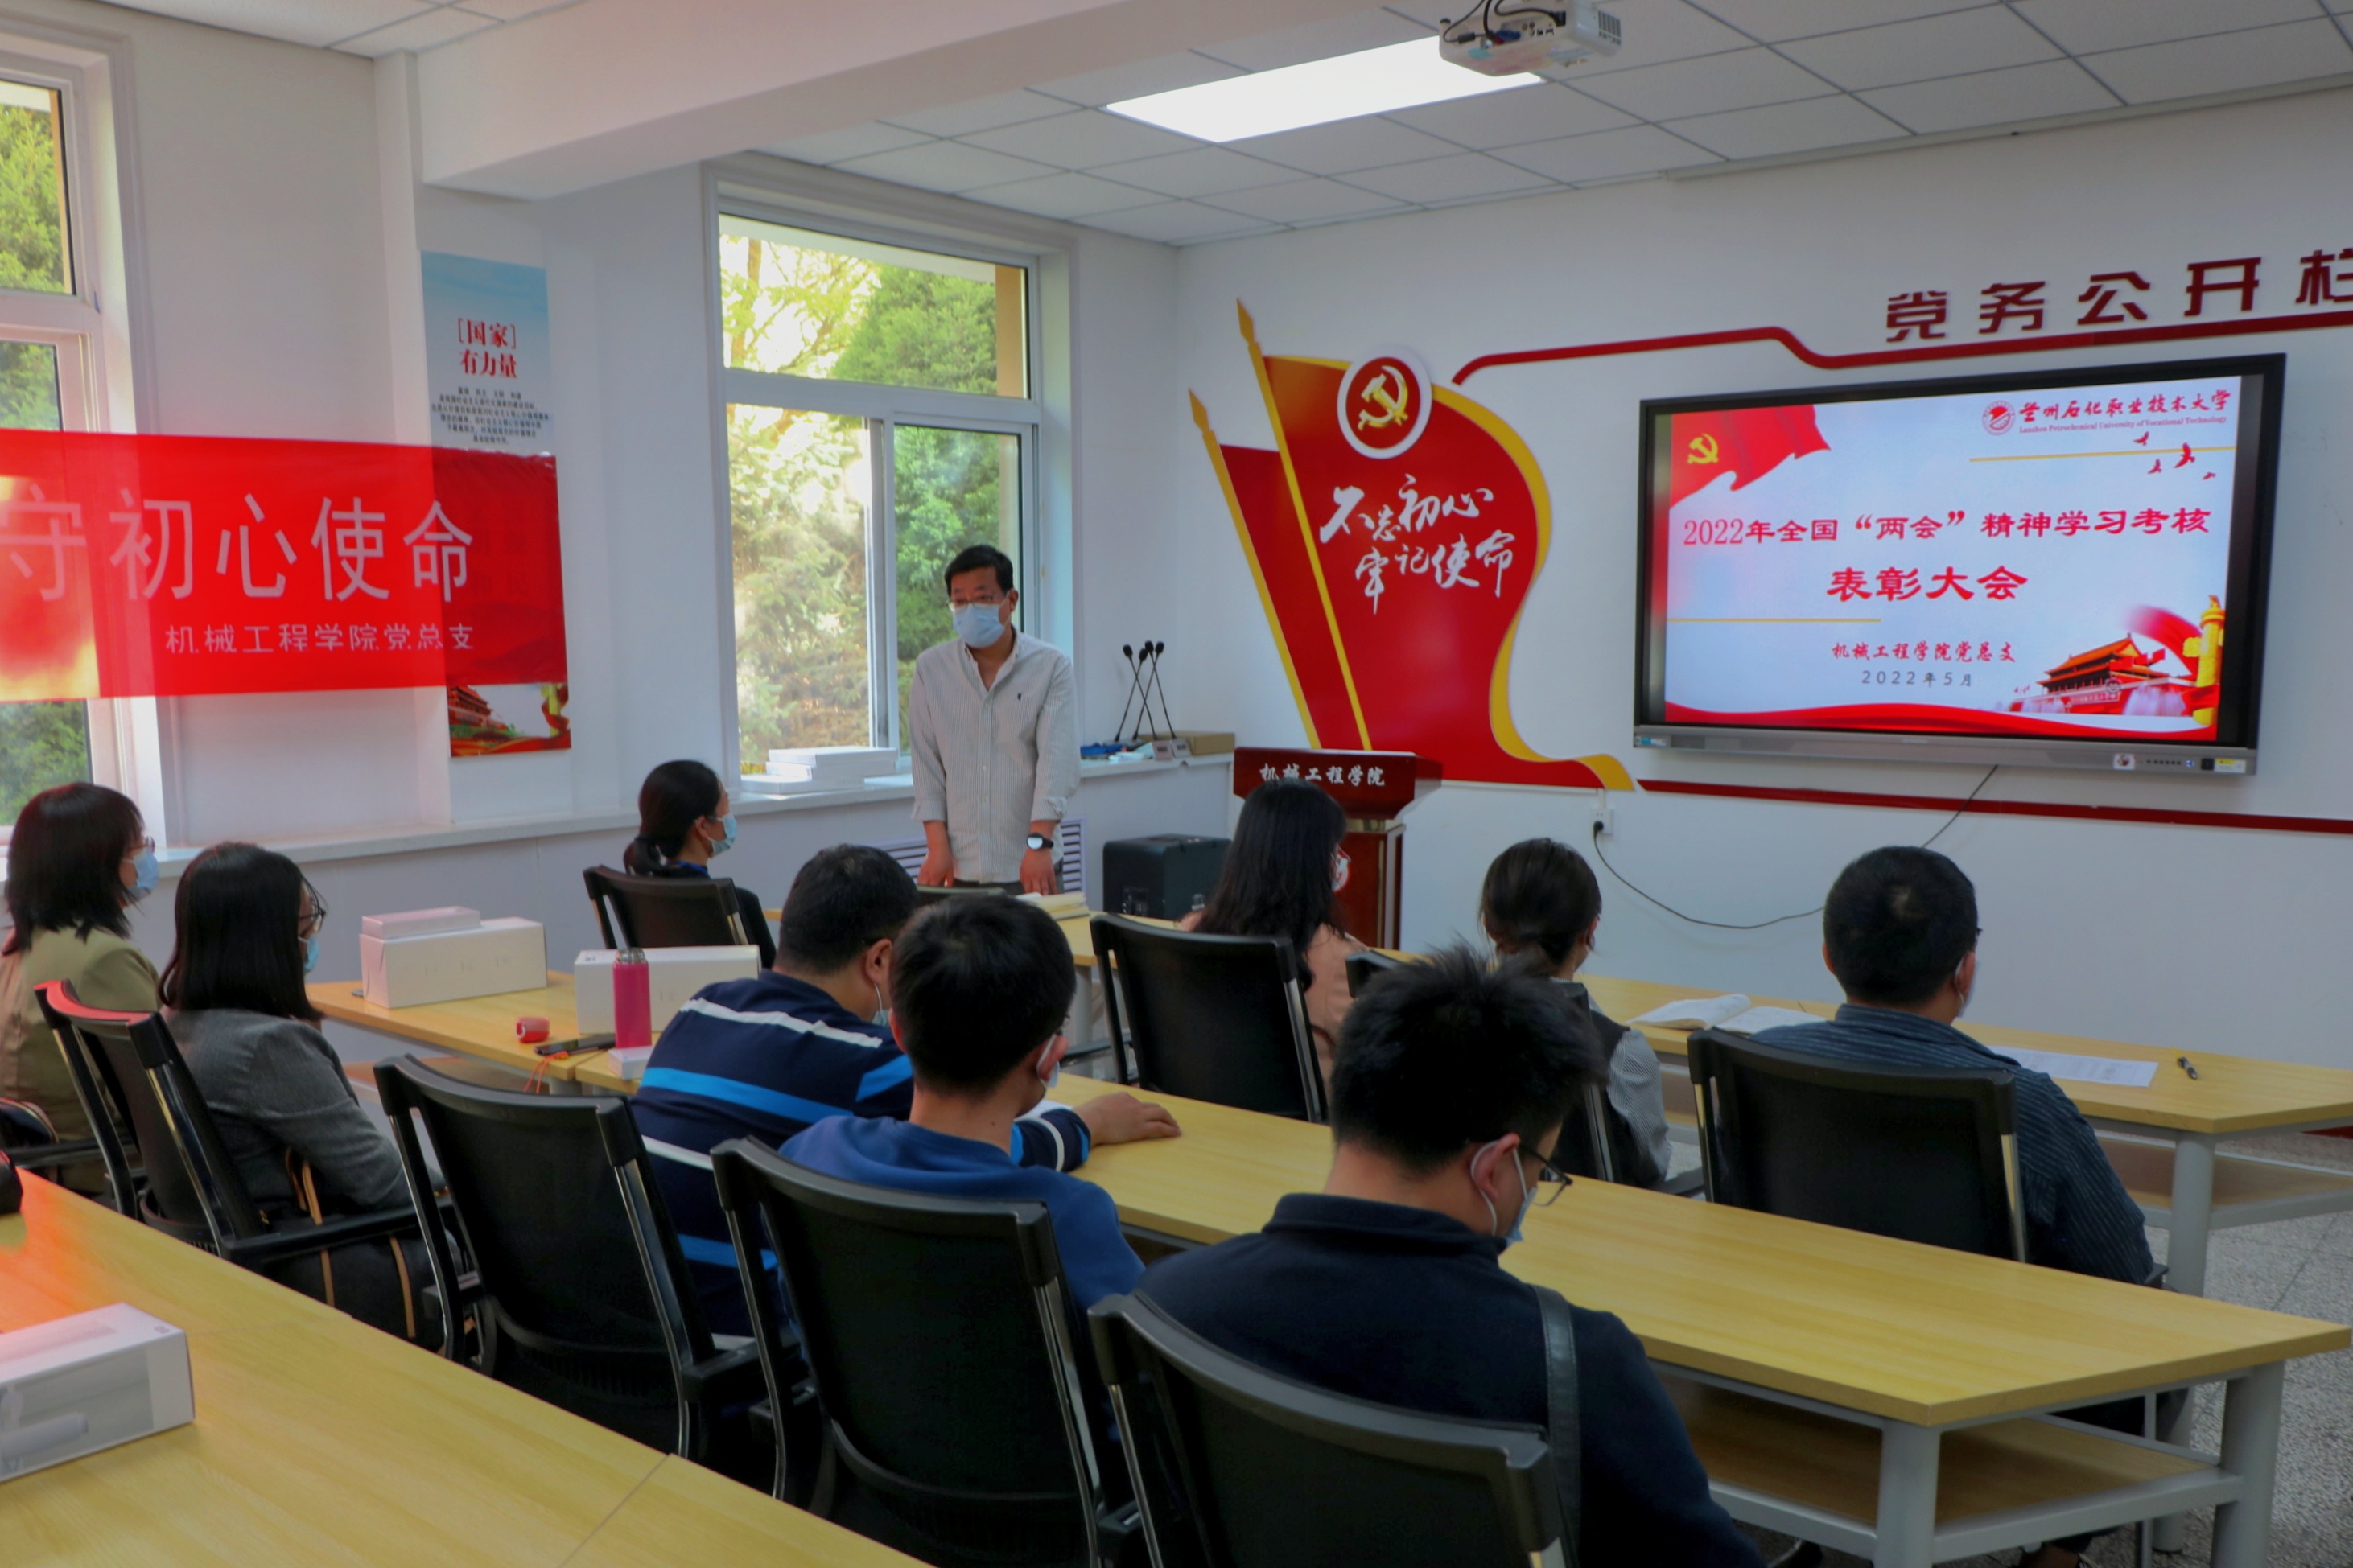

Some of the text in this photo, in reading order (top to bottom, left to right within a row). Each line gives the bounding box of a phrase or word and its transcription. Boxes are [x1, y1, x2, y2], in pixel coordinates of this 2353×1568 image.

[459, 350, 517, 378] 有力量
[2019, 389, 2231, 422] 兰州石化职业技术大学
[2049, 422, 2097, 432] Petrochemical
[2100, 420, 2134, 430] University
[2137, 419, 2145, 427] of
[2145, 417, 2183, 426] Vocational
[2185, 415, 2227, 425] Technology
[1319, 474, 1493, 544] 不忘初心
[1355, 529, 1515, 615] 牢记使命
[1827, 565, 2028, 602] 表彰大会
[166, 622, 475, 655] 机械工程学院党总支
[1832, 640, 2016, 663] 机械工程学院党总支
